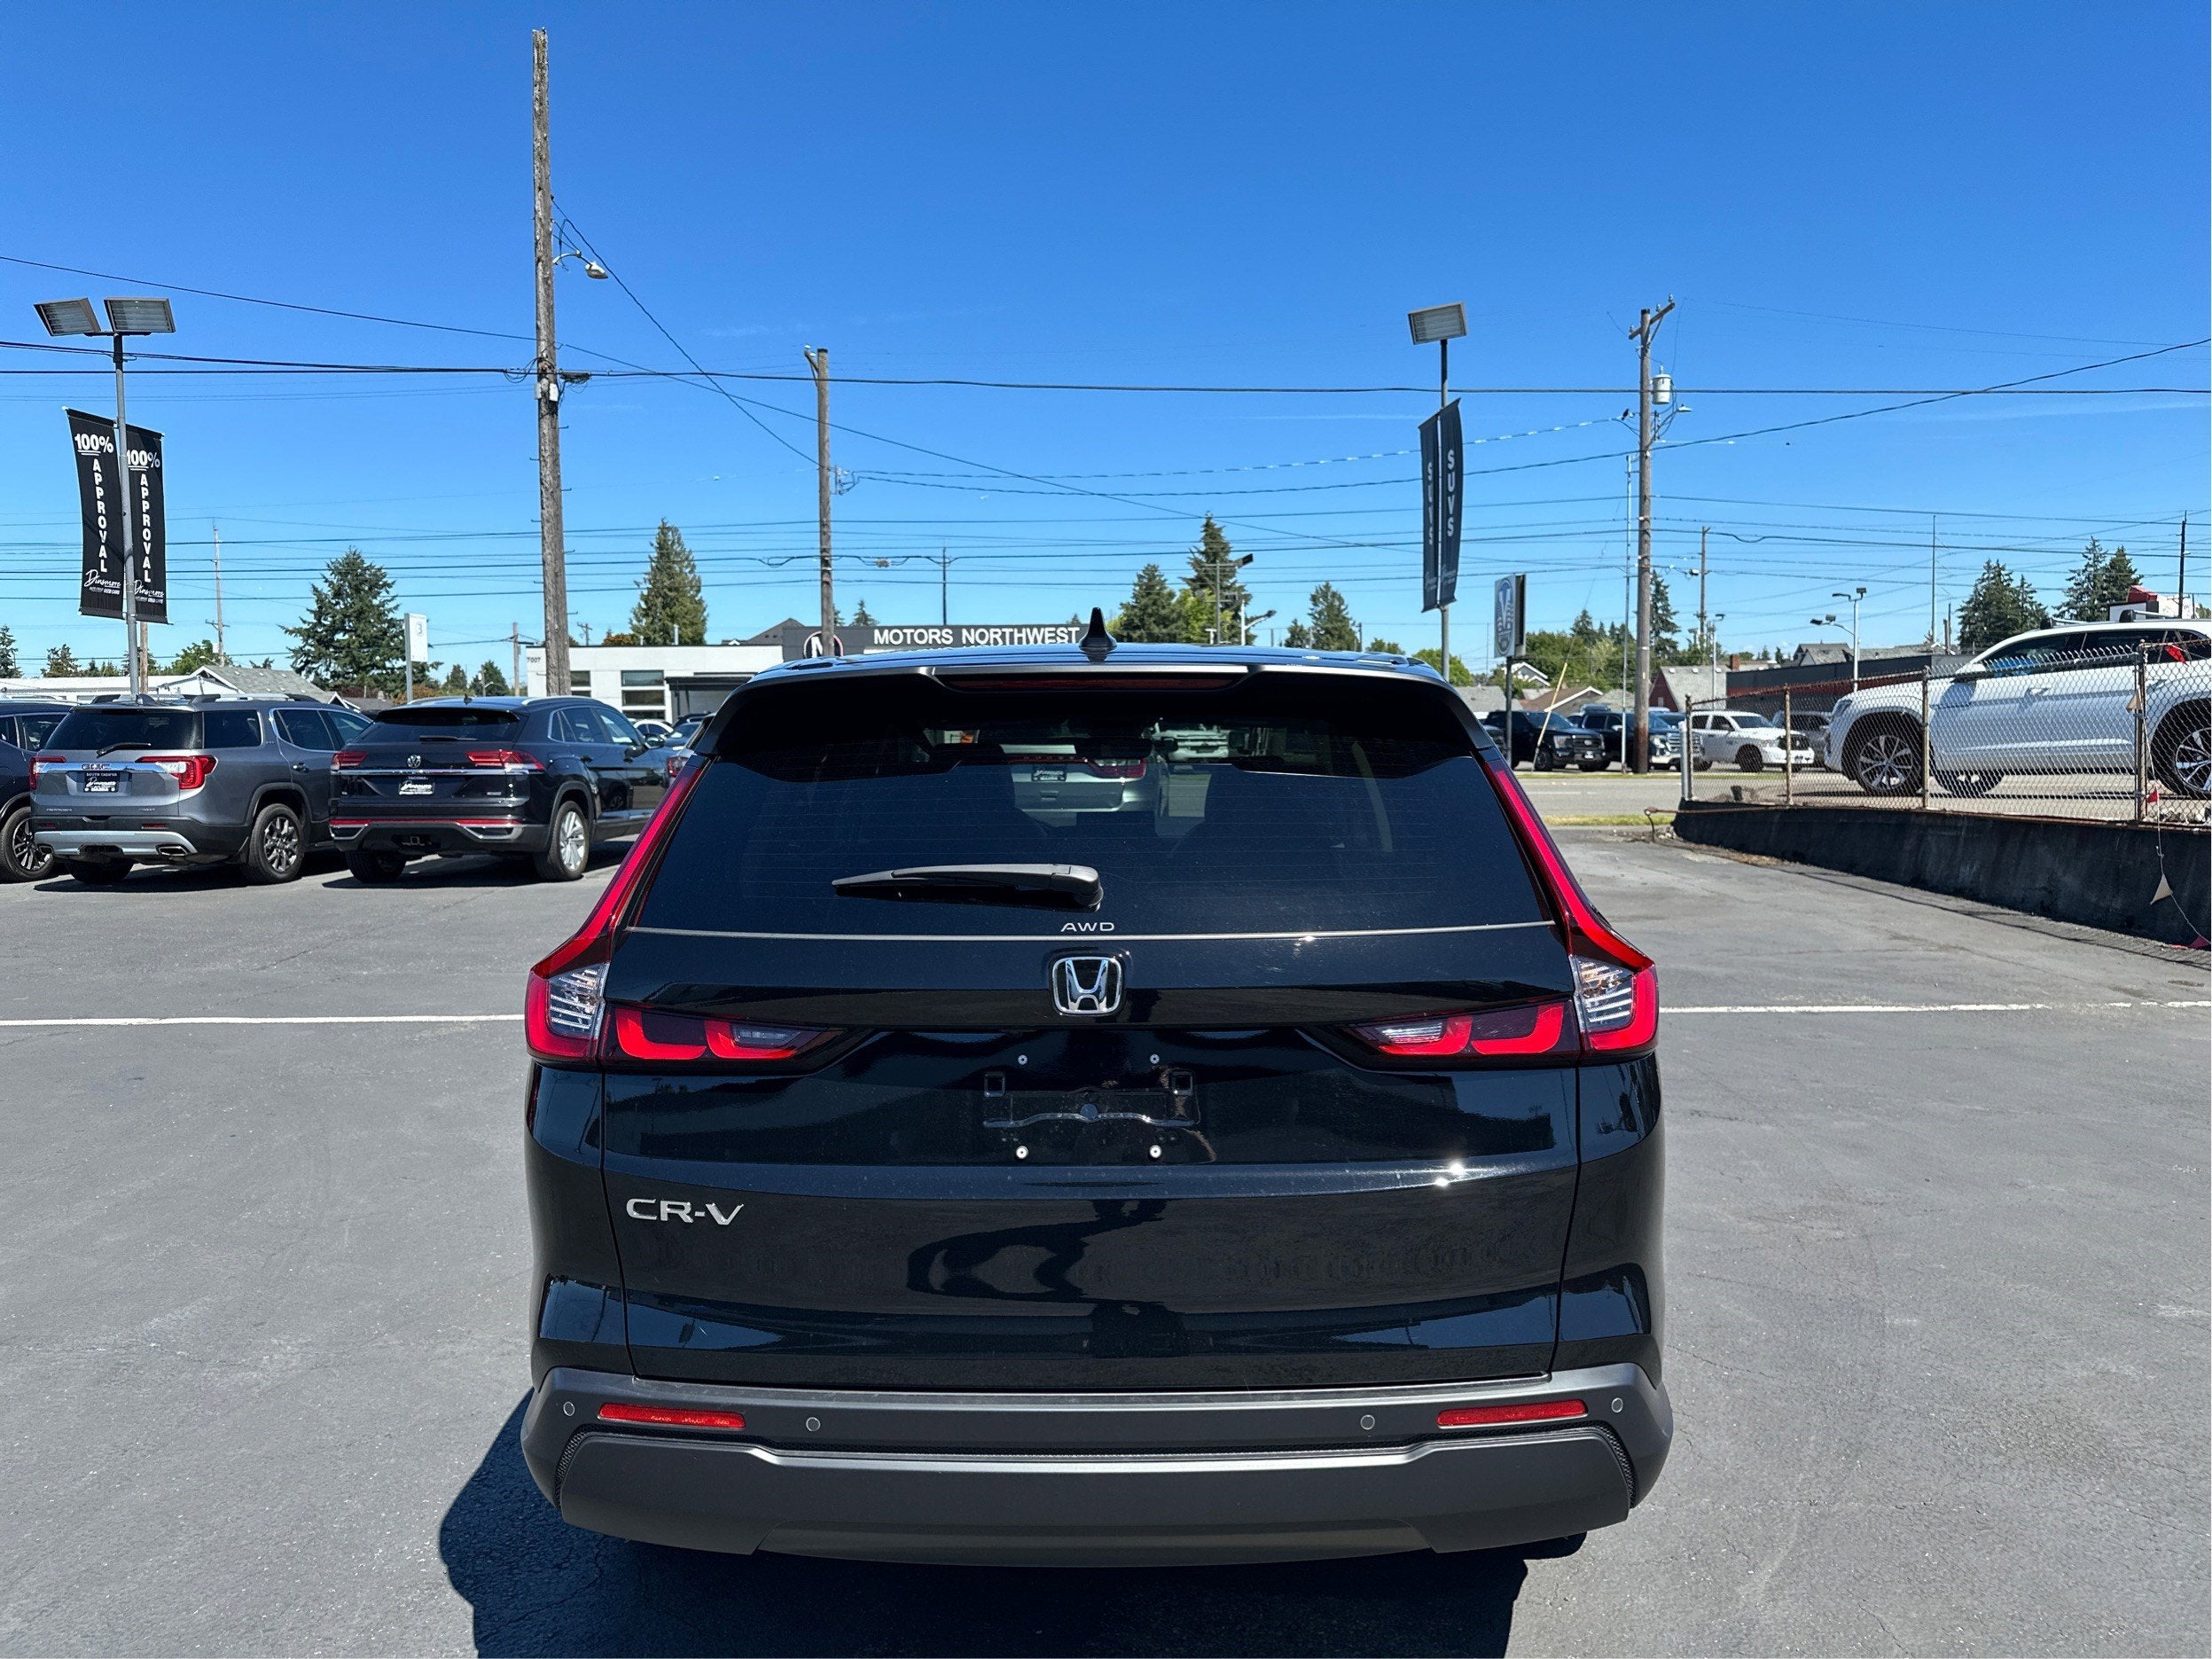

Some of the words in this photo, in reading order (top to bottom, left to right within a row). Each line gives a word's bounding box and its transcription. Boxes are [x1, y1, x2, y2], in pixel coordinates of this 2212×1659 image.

[74, 434, 113, 453] 100%
[127, 450, 160, 468] 100%
[92, 458, 107, 573] APPROVAL
[140, 473, 152, 583] APPROVAL
[873, 629, 954, 646] MOTORS
[962, 626, 1080, 646] NORTHWEST
[1060, 922, 1114, 932] AWD
[626, 1198, 745, 1225] CR-V
